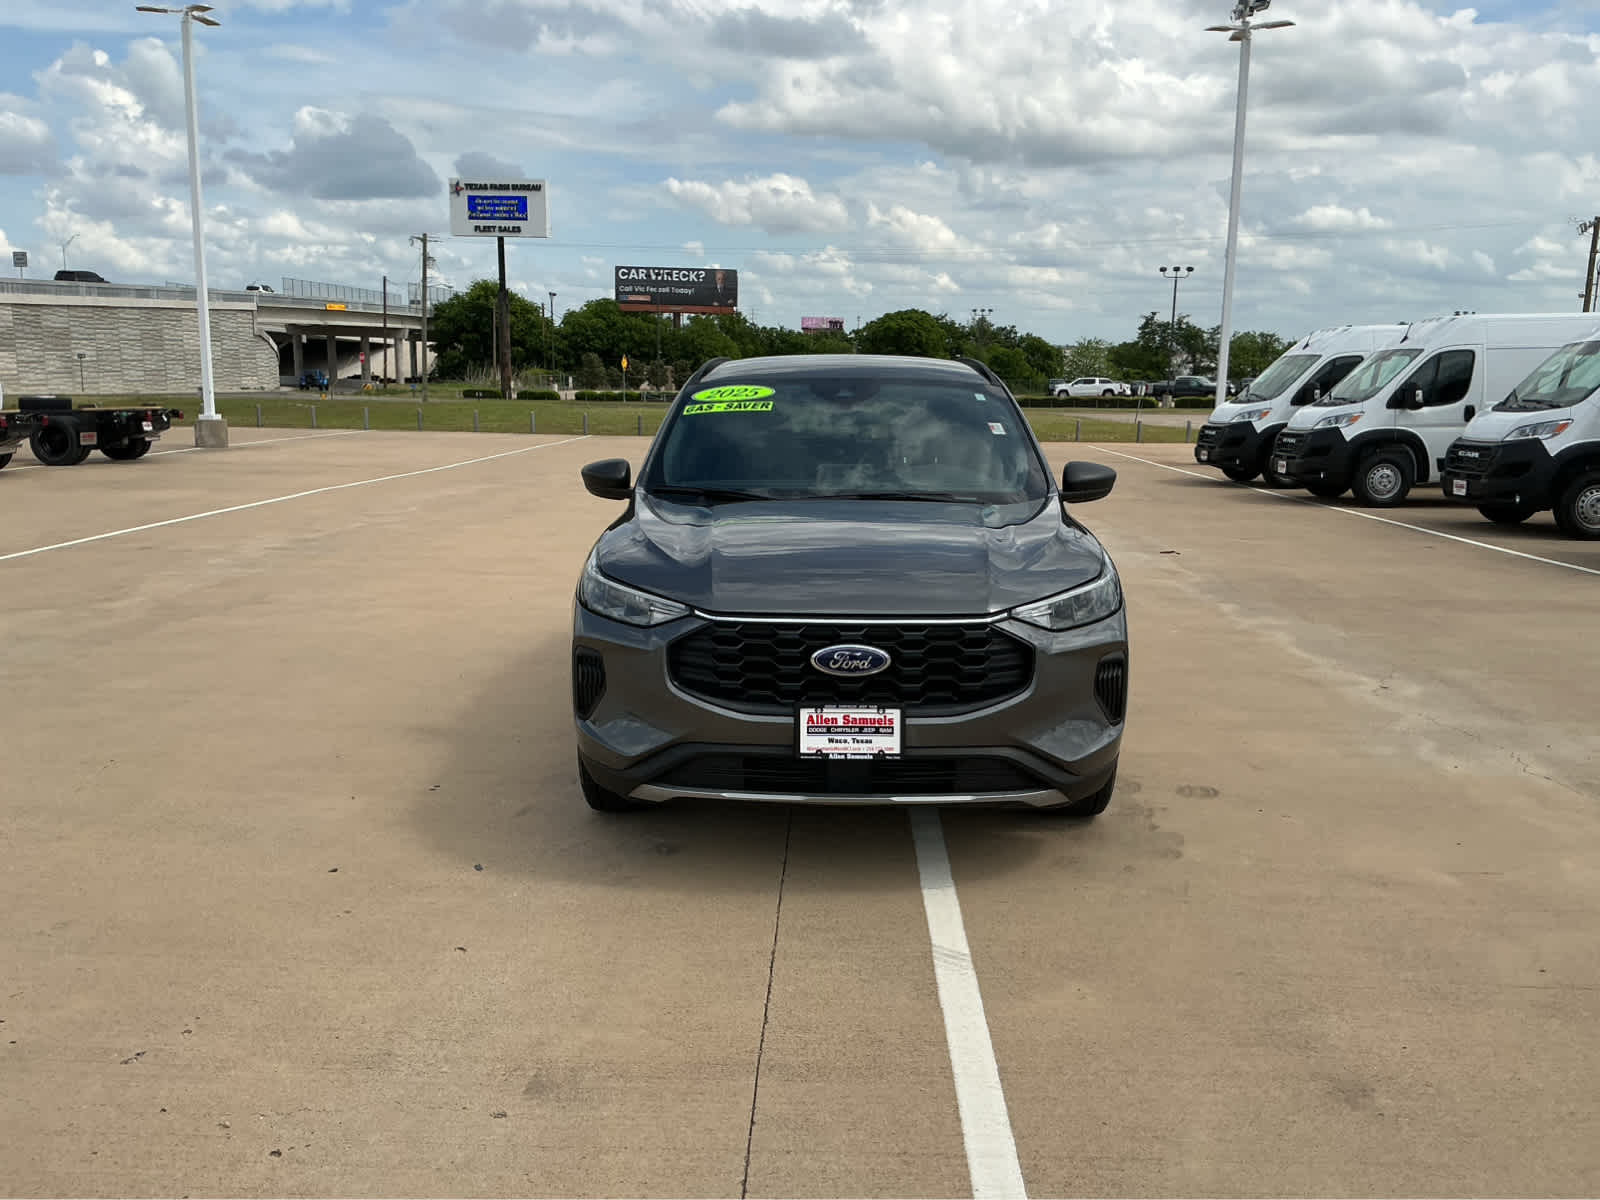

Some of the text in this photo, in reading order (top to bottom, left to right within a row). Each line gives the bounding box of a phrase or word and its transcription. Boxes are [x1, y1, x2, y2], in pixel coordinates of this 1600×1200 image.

[464, 183, 542, 191] TEXAS FARM BUREAU
[618, 268, 706, 282] CAR WRECK?
[704, 387, 761, 399] 2025
[829, 650, 873, 669] Ford
[806, 714, 894, 726] Allen Samuels
[827, 737, 850, 745] Waco,
